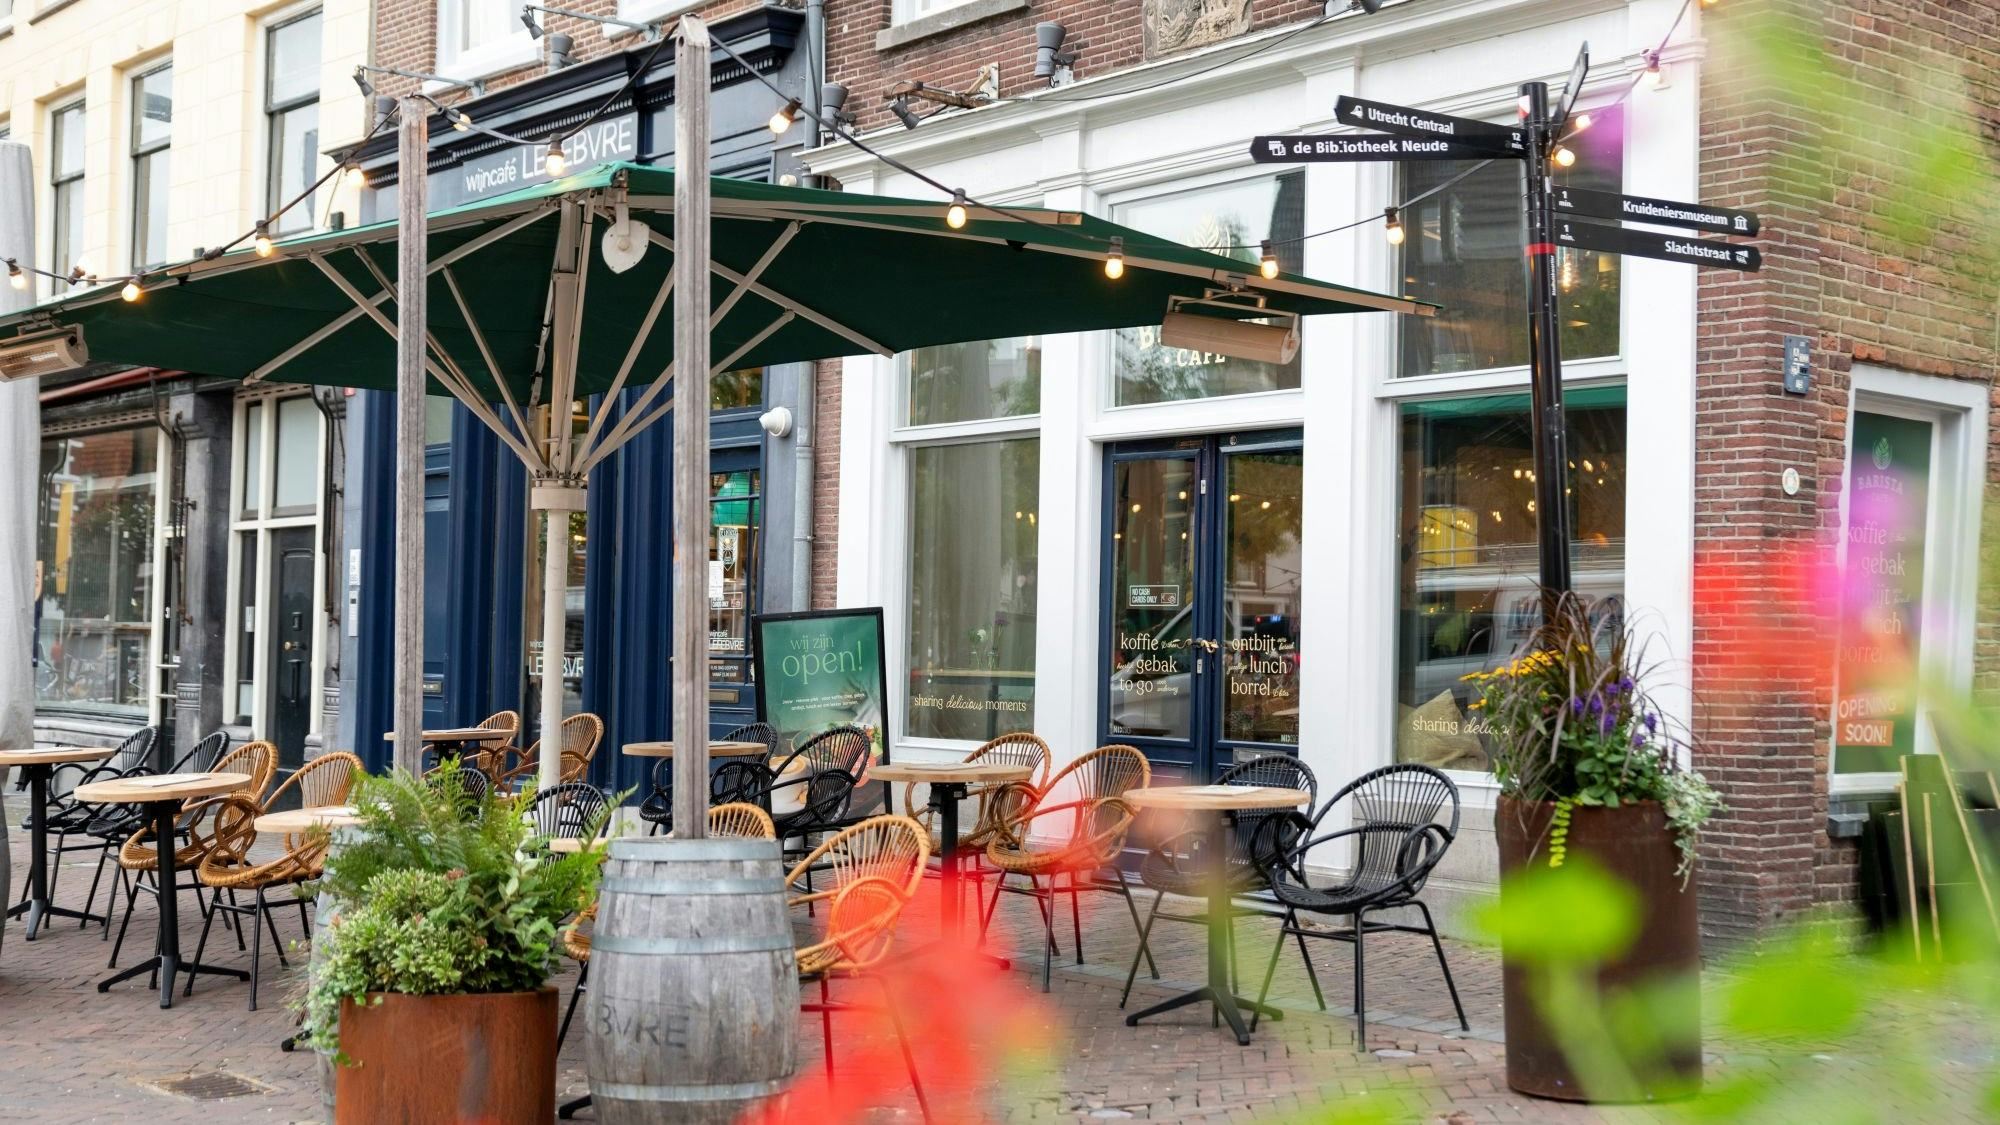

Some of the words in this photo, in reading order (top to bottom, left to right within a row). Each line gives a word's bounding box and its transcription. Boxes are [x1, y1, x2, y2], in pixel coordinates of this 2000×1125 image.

[1368, 108, 1408, 126] Utrecht
[1410, 116, 1454, 134] Centraal
[1293, 141, 1312, 154] de
[1402, 140, 1449, 152] Neude
[1512, 132, 1521, 142] 12
[466, 157, 517, 193] wijncafé
[522, 118, 633, 180] LEEBVRE
[1559, 200, 1574, 208] min.
[1562, 190, 1568, 200] 1
[1623, 200, 1728, 226] Kruideniersmuseum
[1560, 233, 1575, 242] min.
[1563, 224, 1570, 233] 1
[1665, 240, 1731, 261] Slachtstraat
[1857, 475, 1904, 495] BARISTA
[1862, 550, 1906, 577] gebak
[1139, 588, 1150, 596] CASH
[1146, 596, 1158, 604] ONLY
[790, 634, 809, 652] wij
[813, 634, 834, 651] zijn
[1120, 632, 1159, 650] koffie
[1232, 633, 1276, 655] ontbijt
[782, 640, 862, 685] open!
[1136, 654, 1178, 674] gebak
[1250, 654, 1288, 674] lunch
[1120, 678, 1134, 692] to
[1136, 680, 1154, 696] go
[1231, 676, 1270, 696] borrel
[914, 694, 943, 710] sharing
[946, 694, 982, 710] delicious
[985, 700, 1027, 712] moments
[1839, 695, 1897, 719] OPENING
[1412, 716, 1458, 736] sharing
[1845, 723, 1887, 743] SOON!
